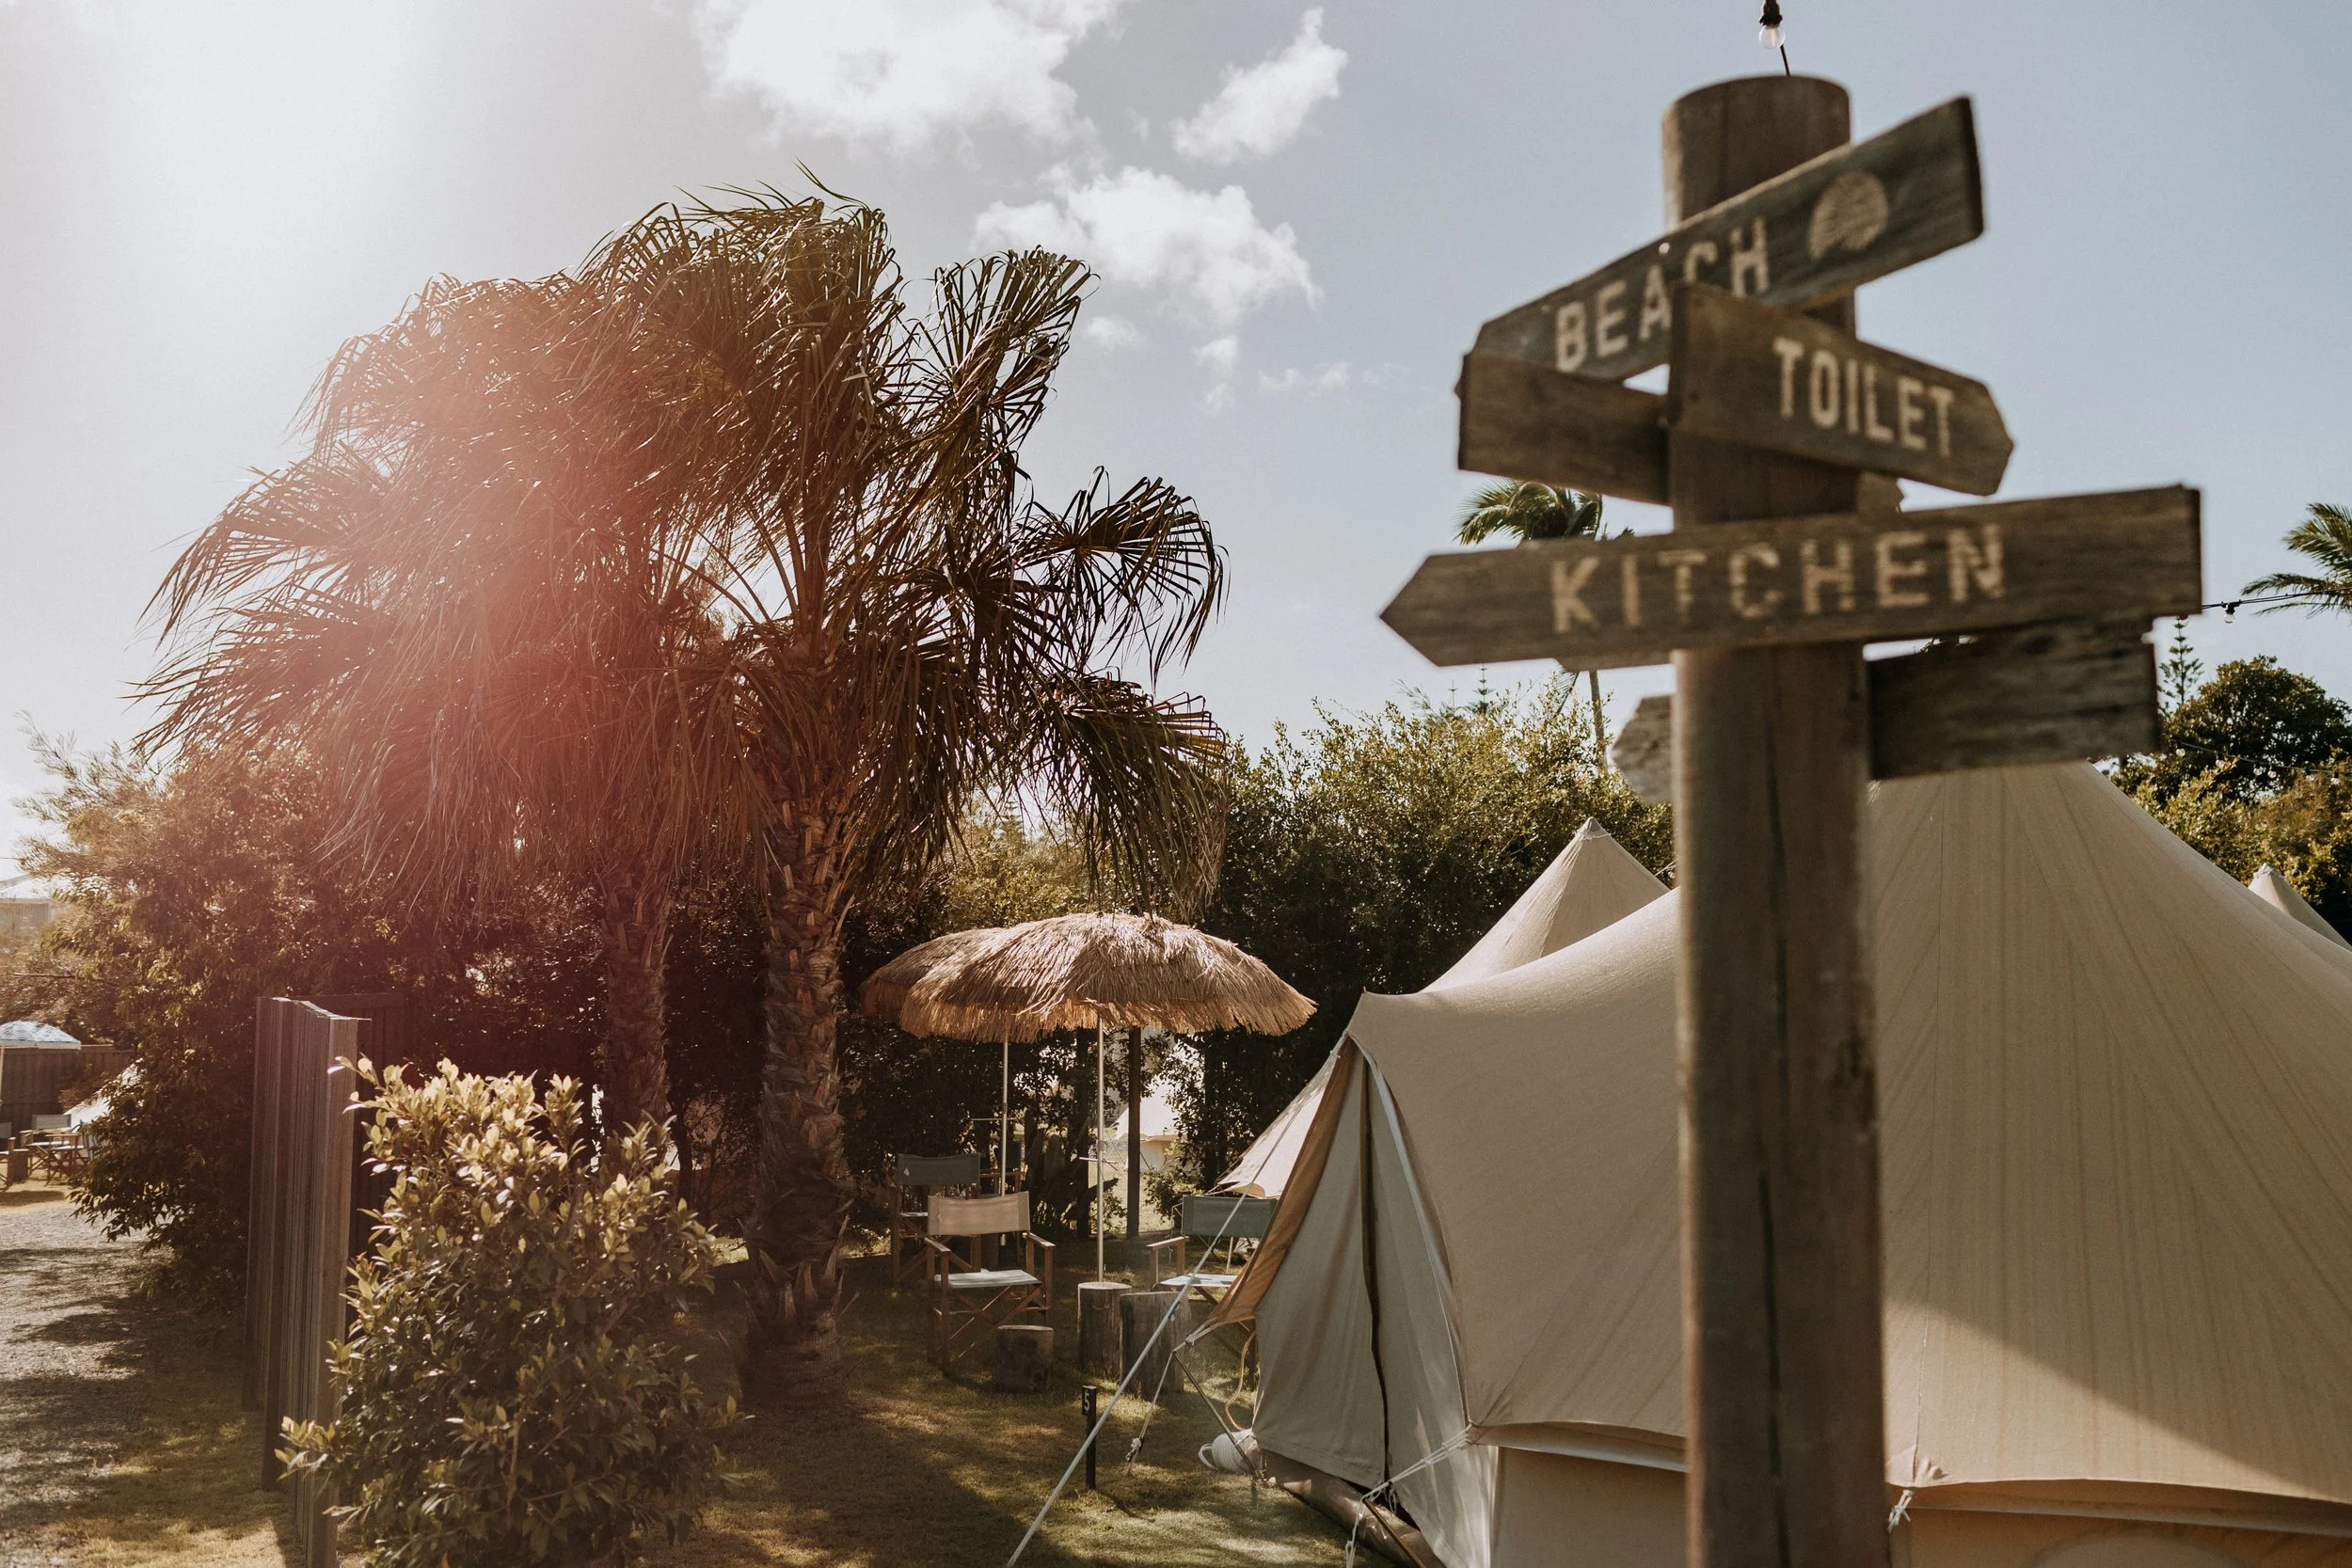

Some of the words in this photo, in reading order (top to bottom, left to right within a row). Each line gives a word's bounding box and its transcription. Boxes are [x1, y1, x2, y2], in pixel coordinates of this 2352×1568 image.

[1555, 216, 1770, 372] BEACH
[1772, 336, 1956, 459] TOILET
[1550, 523, 2006, 635] KITCHEN
[1084, 1390, 1090, 1412] 5
